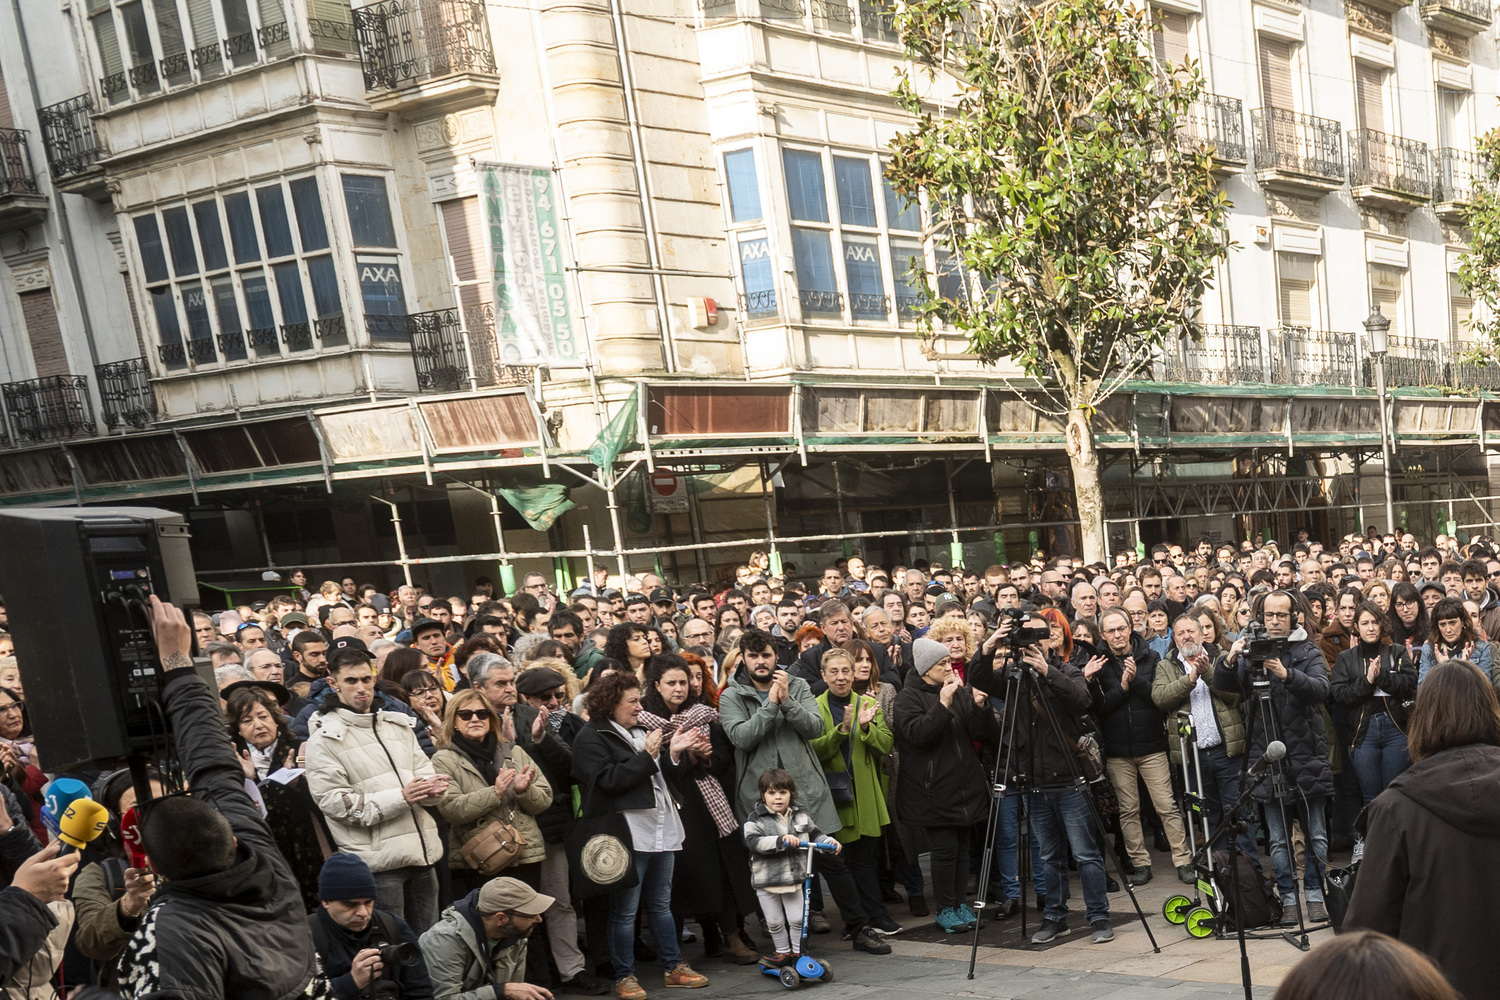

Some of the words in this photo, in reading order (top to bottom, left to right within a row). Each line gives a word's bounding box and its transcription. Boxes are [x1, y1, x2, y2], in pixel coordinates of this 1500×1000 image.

[534, 176, 552, 212] 94
[484, 167, 519, 339] ANBASA
[540, 221, 558, 274] 671
[742, 241, 770, 261] AXA
[846, 245, 876, 263] AXA
[360, 266, 400, 284] AXA
[548, 283, 568, 319] 05
[553, 322, 575, 358] 50
